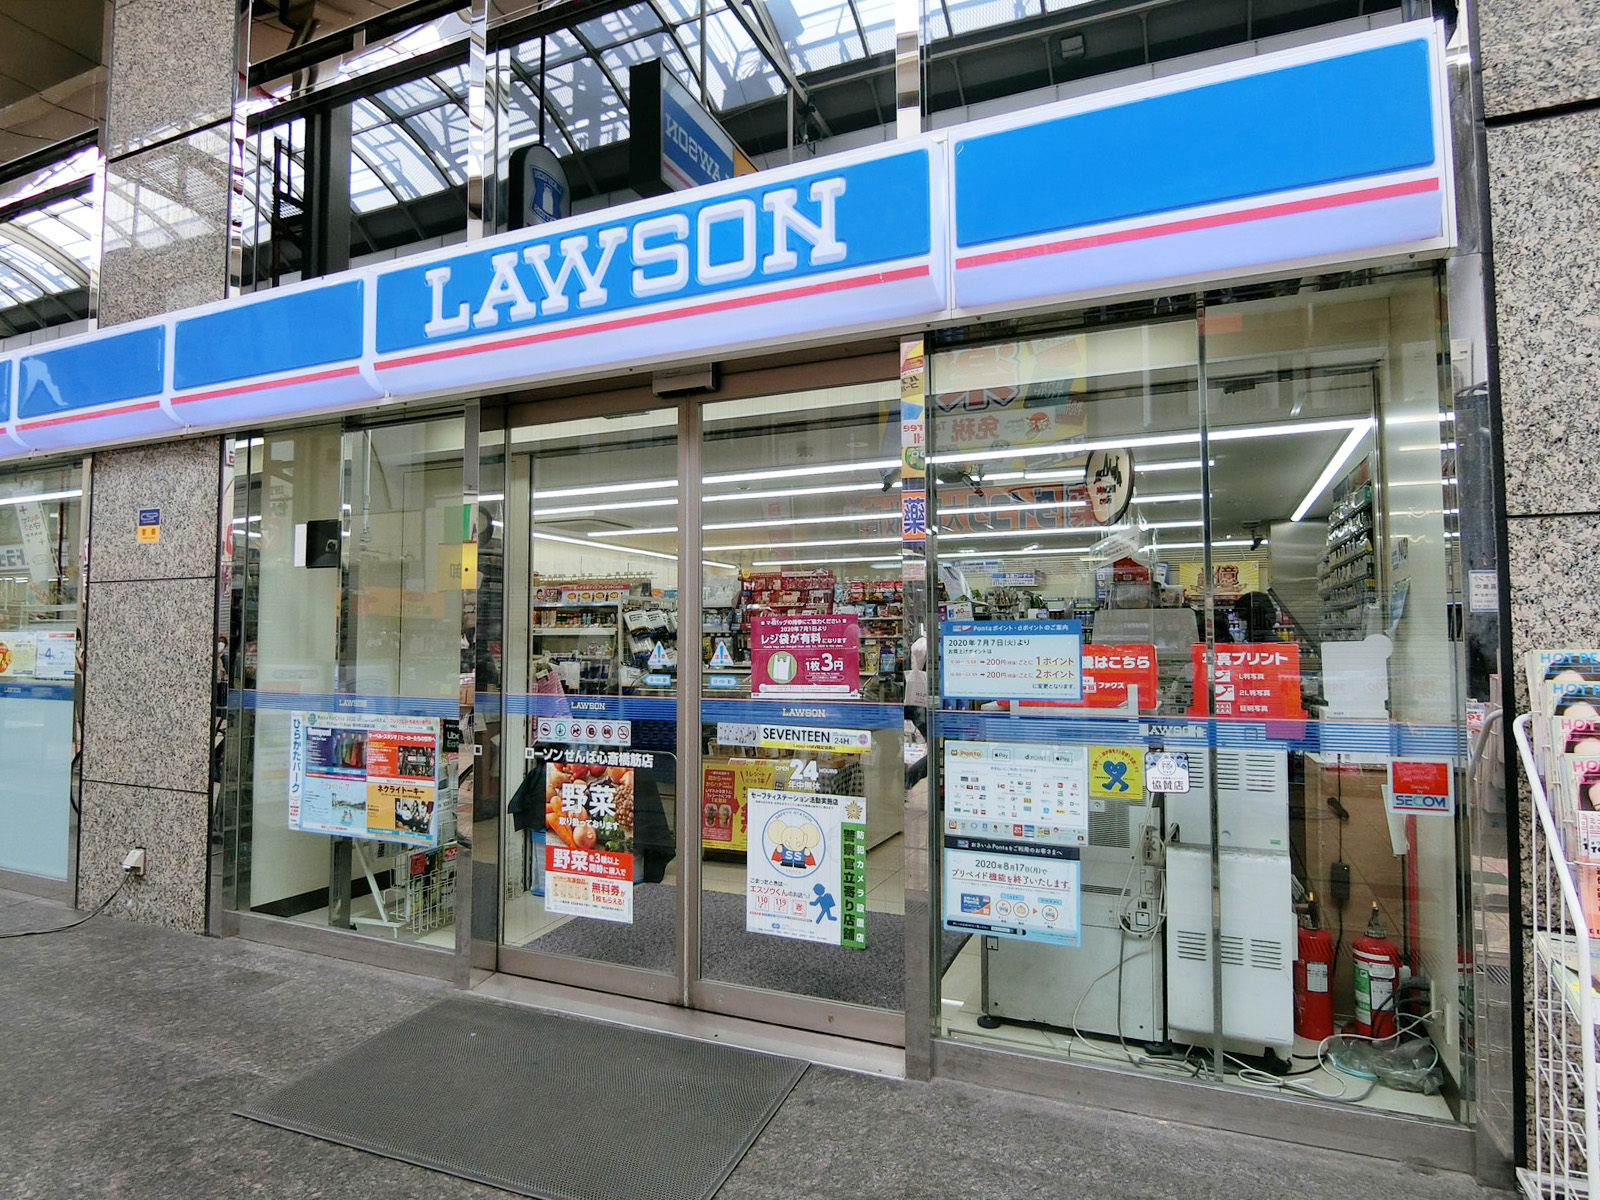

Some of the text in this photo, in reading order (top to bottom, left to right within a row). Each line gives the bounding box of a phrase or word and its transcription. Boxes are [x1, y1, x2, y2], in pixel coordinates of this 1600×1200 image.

[425, 177, 847, 339] LAWSON
[805, 652, 844, 672] 1枚3円
[1541, 653, 1575, 664] HOT
[1553, 683, 1588, 695] HOT
[571, 701, 606, 710] LAWSON
[782, 708, 826, 718] LAWSON
[1561, 719, 1597, 731] HOT
[763, 727, 830, 744] SEVENTEEN
[834, 736, 850, 745] 24H
[292, 719, 302, 793] ひらかたパーク
[789, 759, 819, 782] 24
[377, 785, 426, 795] ネクライトーキー
[788, 780, 821, 792] 年中無休
[1152, 780, 1184, 791] 協賛店
[562, 783, 616, 817] 野菜
[751, 791, 839, 806] セーフティステーション活動実施店
[1396, 795, 1446, 808] SECOM
[558, 816, 620, 830] 取り扱っております
[553, 848, 588, 871] 野菜
[785, 851, 802, 861] SS
[843, 829, 855, 941] 警察官立寄り店舗
[856, 830, 865, 943] 防犯カメラ設置店
[757, 896, 768, 904] 110
[776, 898, 787, 906] 119
